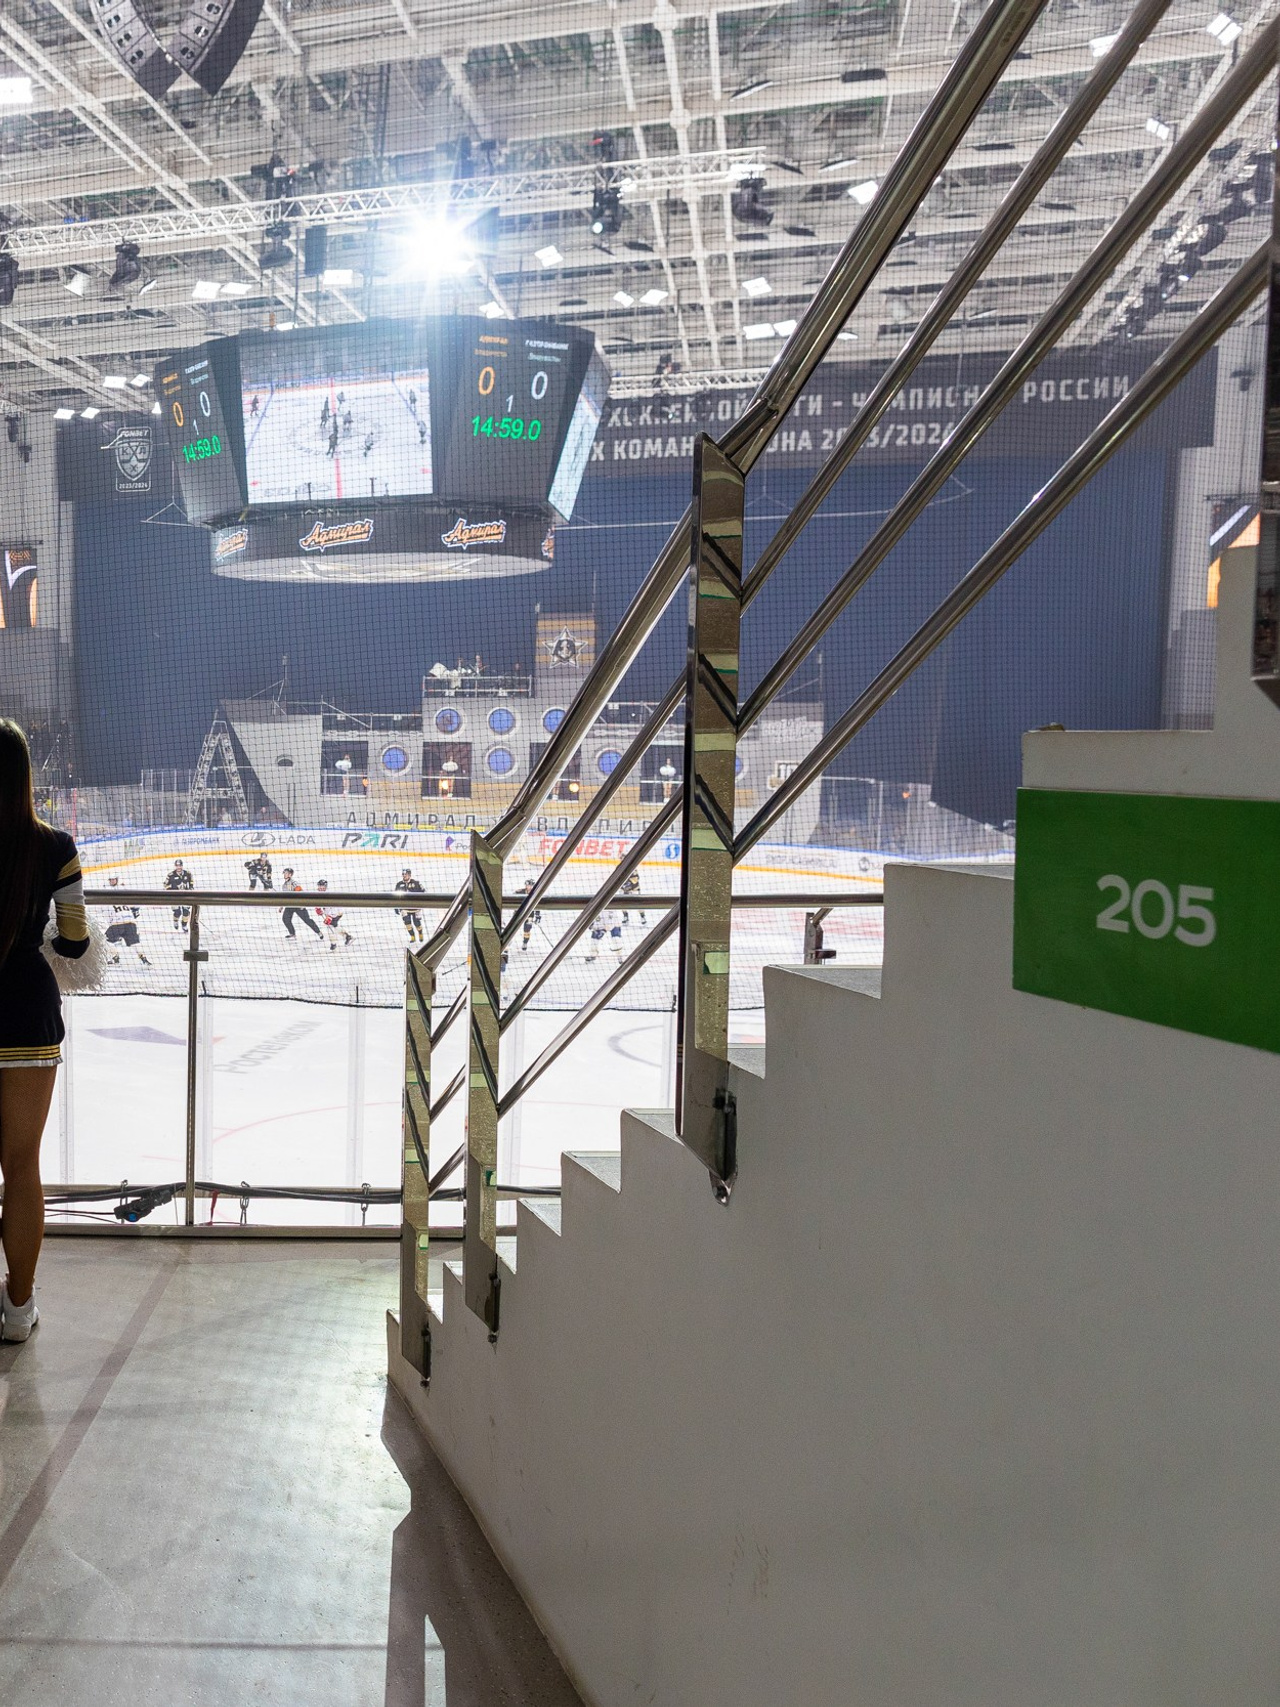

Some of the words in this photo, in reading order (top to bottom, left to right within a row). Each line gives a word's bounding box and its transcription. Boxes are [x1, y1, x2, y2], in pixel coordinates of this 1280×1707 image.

[478, 366, 495, 395] 0
[531, 371, 548, 400] 0
[1023, 376, 1130, 403] РОССИИ
[172, 402, 184, 427] 0
[200, 391, 210, 417] 0
[506, 395, 514, 413] 1
[193, 420, 199, 436] 1
[471, 415, 542, 441] 14:59.0
[182, 435, 222, 463] 14:59.0
[303, 521, 372, 549] Адмирал
[447, 521, 506, 546] Адмирал
[278, 837, 316, 846] LADA
[341, 832, 408, 848] PARI
[1096, 874, 1217, 947] 205
